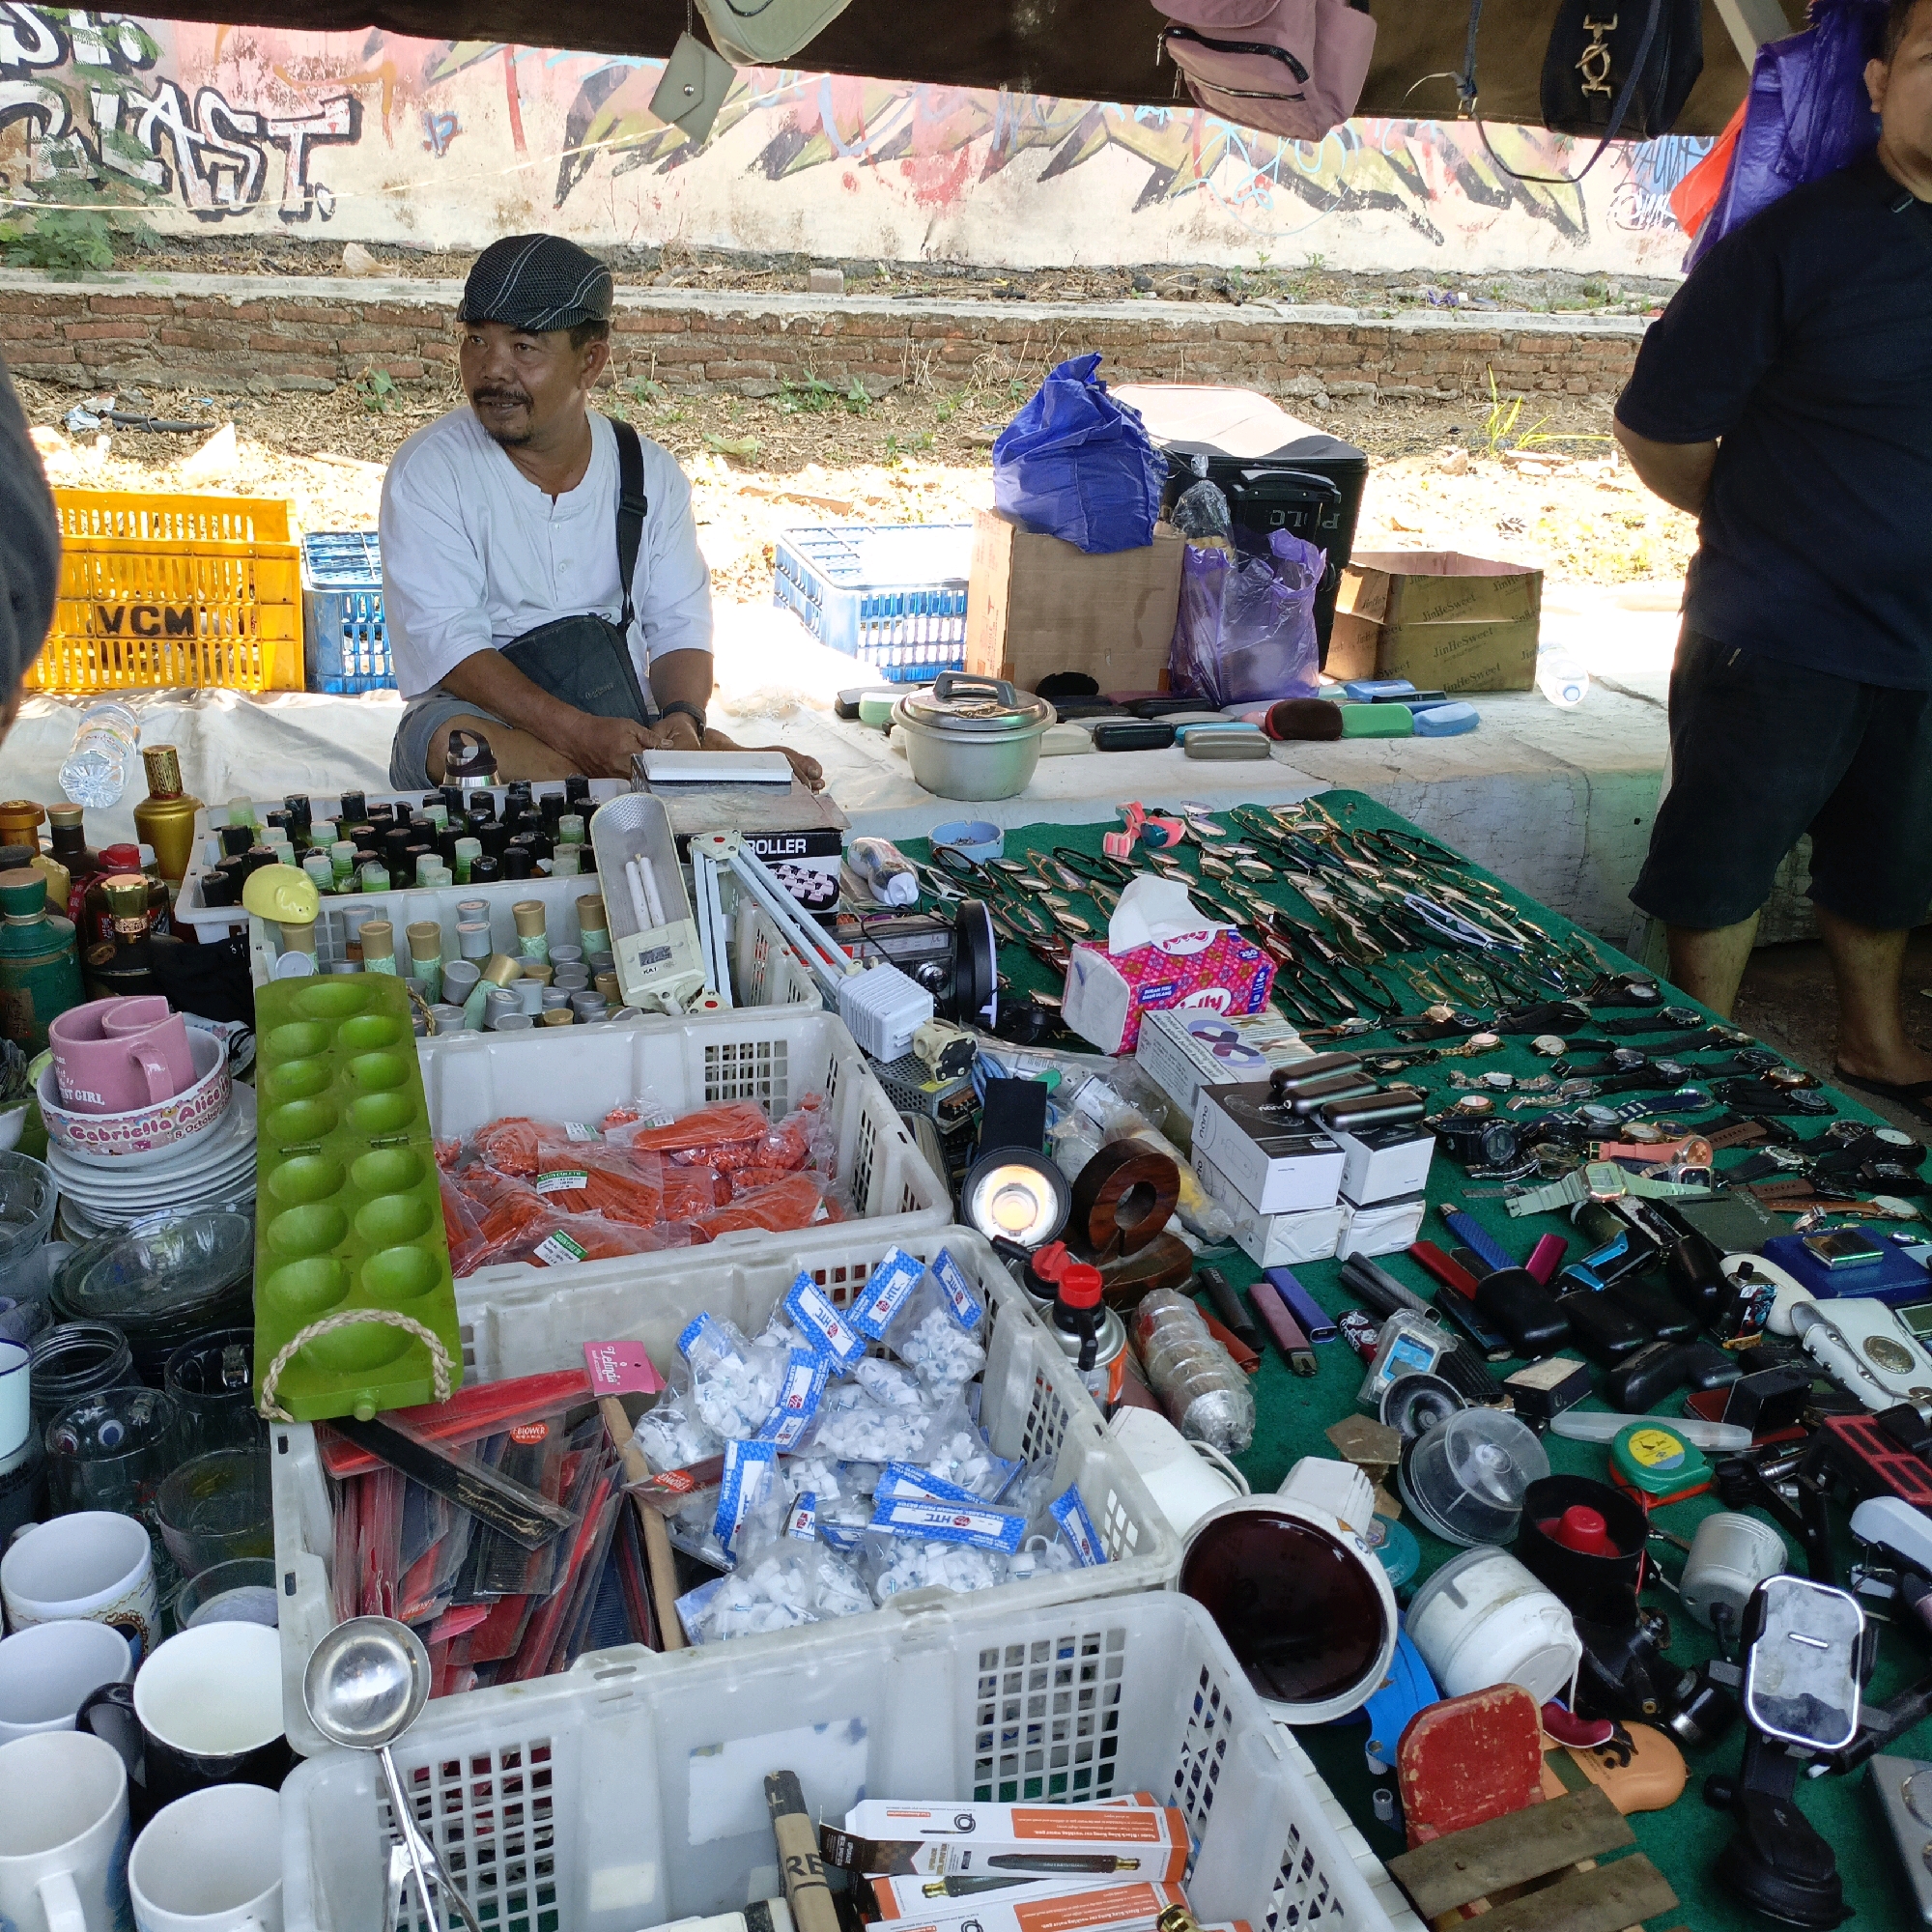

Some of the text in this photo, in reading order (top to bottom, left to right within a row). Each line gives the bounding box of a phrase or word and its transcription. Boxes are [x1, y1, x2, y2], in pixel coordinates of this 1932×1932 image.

[1422, 592, 1477, 622] JinHeSweet
[98, 605, 195, 637] VCM
[1433, 626, 1493, 658] JinHeSweet
[1442, 662, 1501, 693] JinHeSweet
[75, 1089, 105, 1106] GIRL
[185, 1111, 222, 1132] October
[1199, 1105, 1208, 1138] nano
[883, 1281, 901, 1302] HTC
[812, 1306, 833, 1328] HTC
[895, 1500, 918, 1510] BETON
[923, 1512, 952, 1524] HTC
